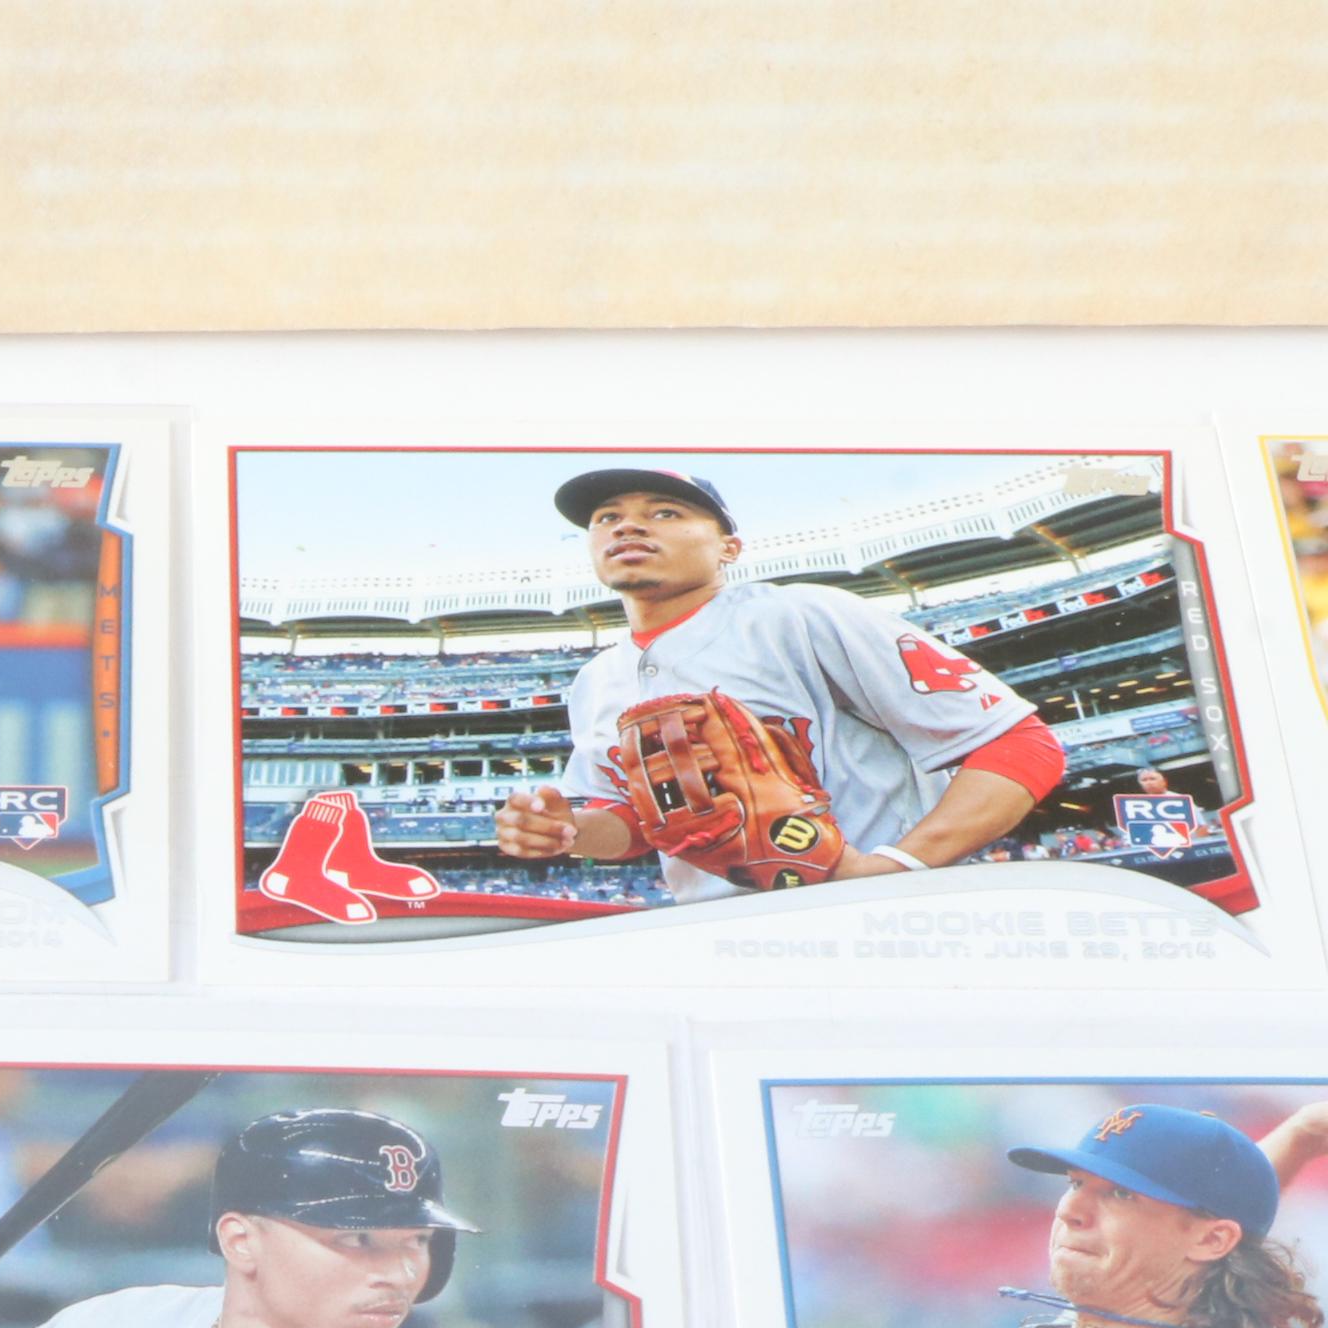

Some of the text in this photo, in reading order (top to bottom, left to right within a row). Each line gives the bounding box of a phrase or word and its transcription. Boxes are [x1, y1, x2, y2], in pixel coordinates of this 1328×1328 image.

[99, 584, 119, 709] METS
[1180, 581, 1230, 752] RED SOX
[1124, 799, 1187, 820] RC
[862, 909, 1219, 937] MOOKIE BETTS
[713, 940, 840, 959] ROOKIE
[853, 940, 973, 959] DEBUT:
[984, 941, 1070, 960] JUNE
[1140, 941, 1217, 960] 2014
[378, 1144, 418, 1193] B
